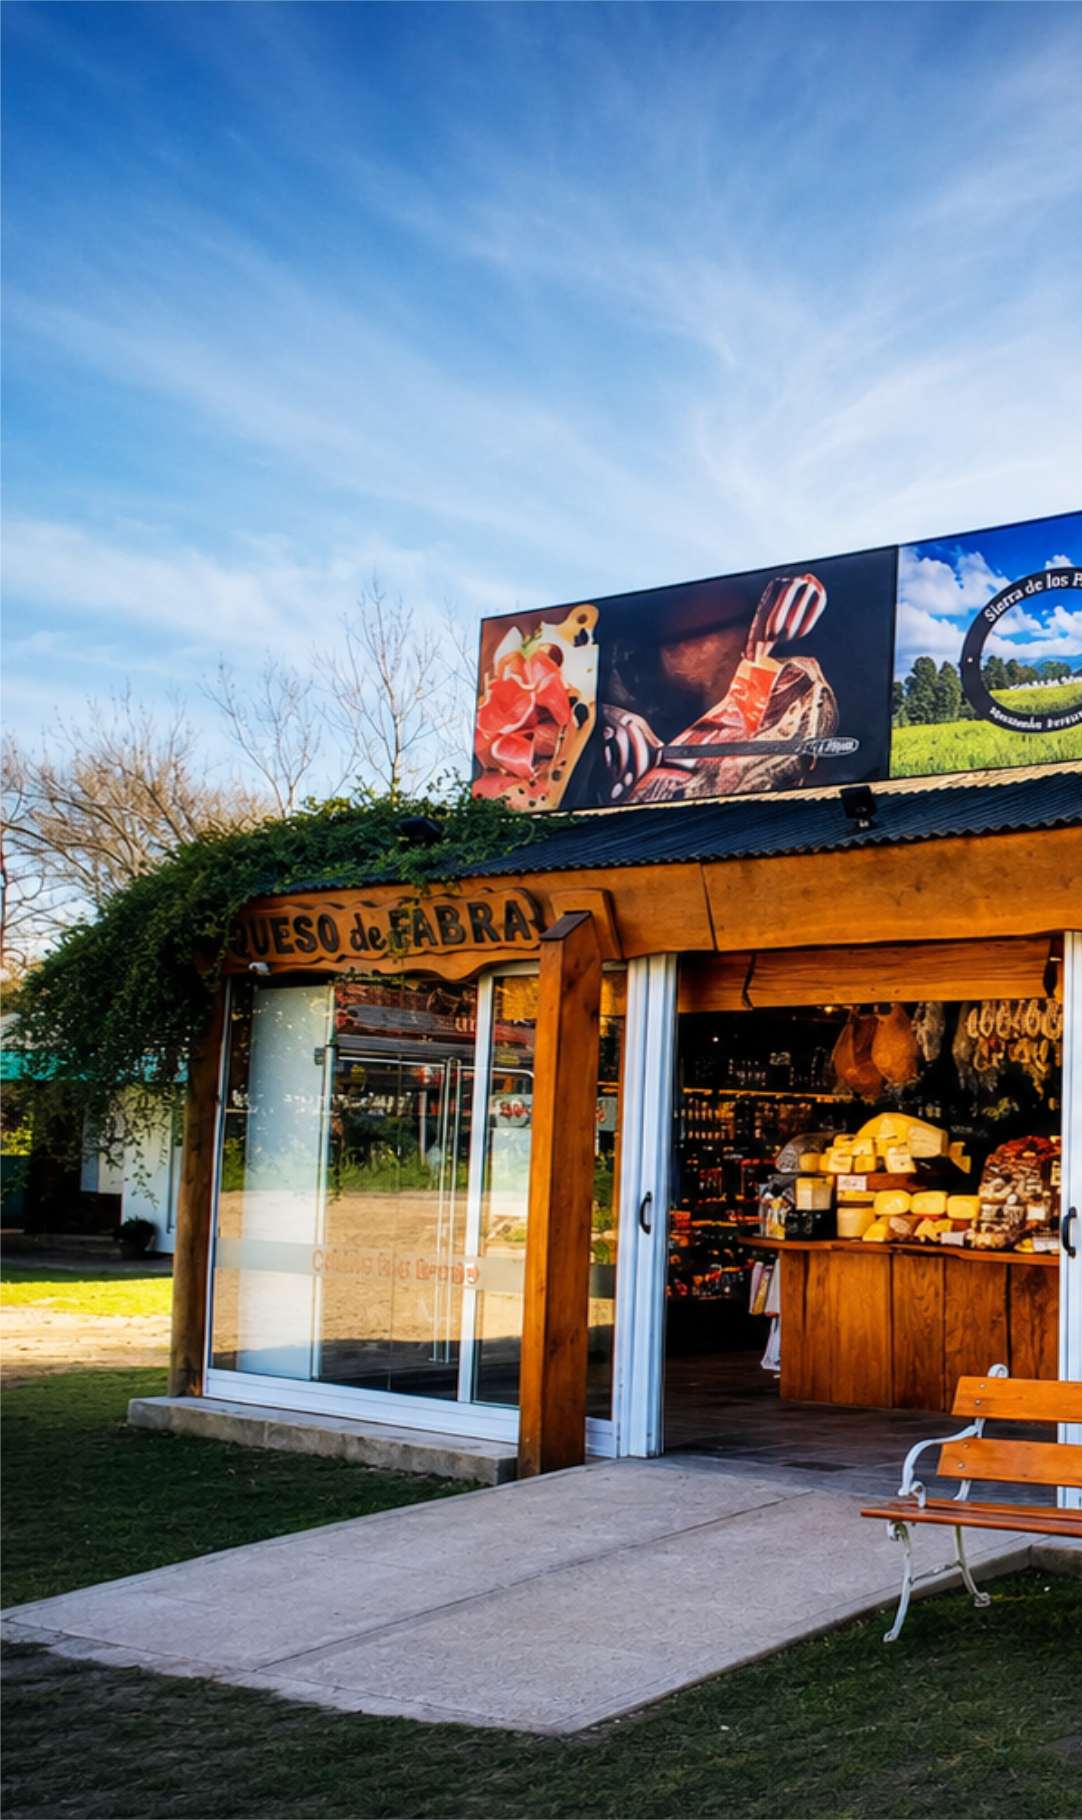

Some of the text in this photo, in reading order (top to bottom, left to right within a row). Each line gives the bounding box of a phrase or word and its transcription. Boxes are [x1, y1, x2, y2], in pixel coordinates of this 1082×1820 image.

[984, 588, 1024, 622] Sierra
[1025, 579, 1044, 594] de
[1046, 573, 1069, 589] los
[350, 912, 387, 952] de
